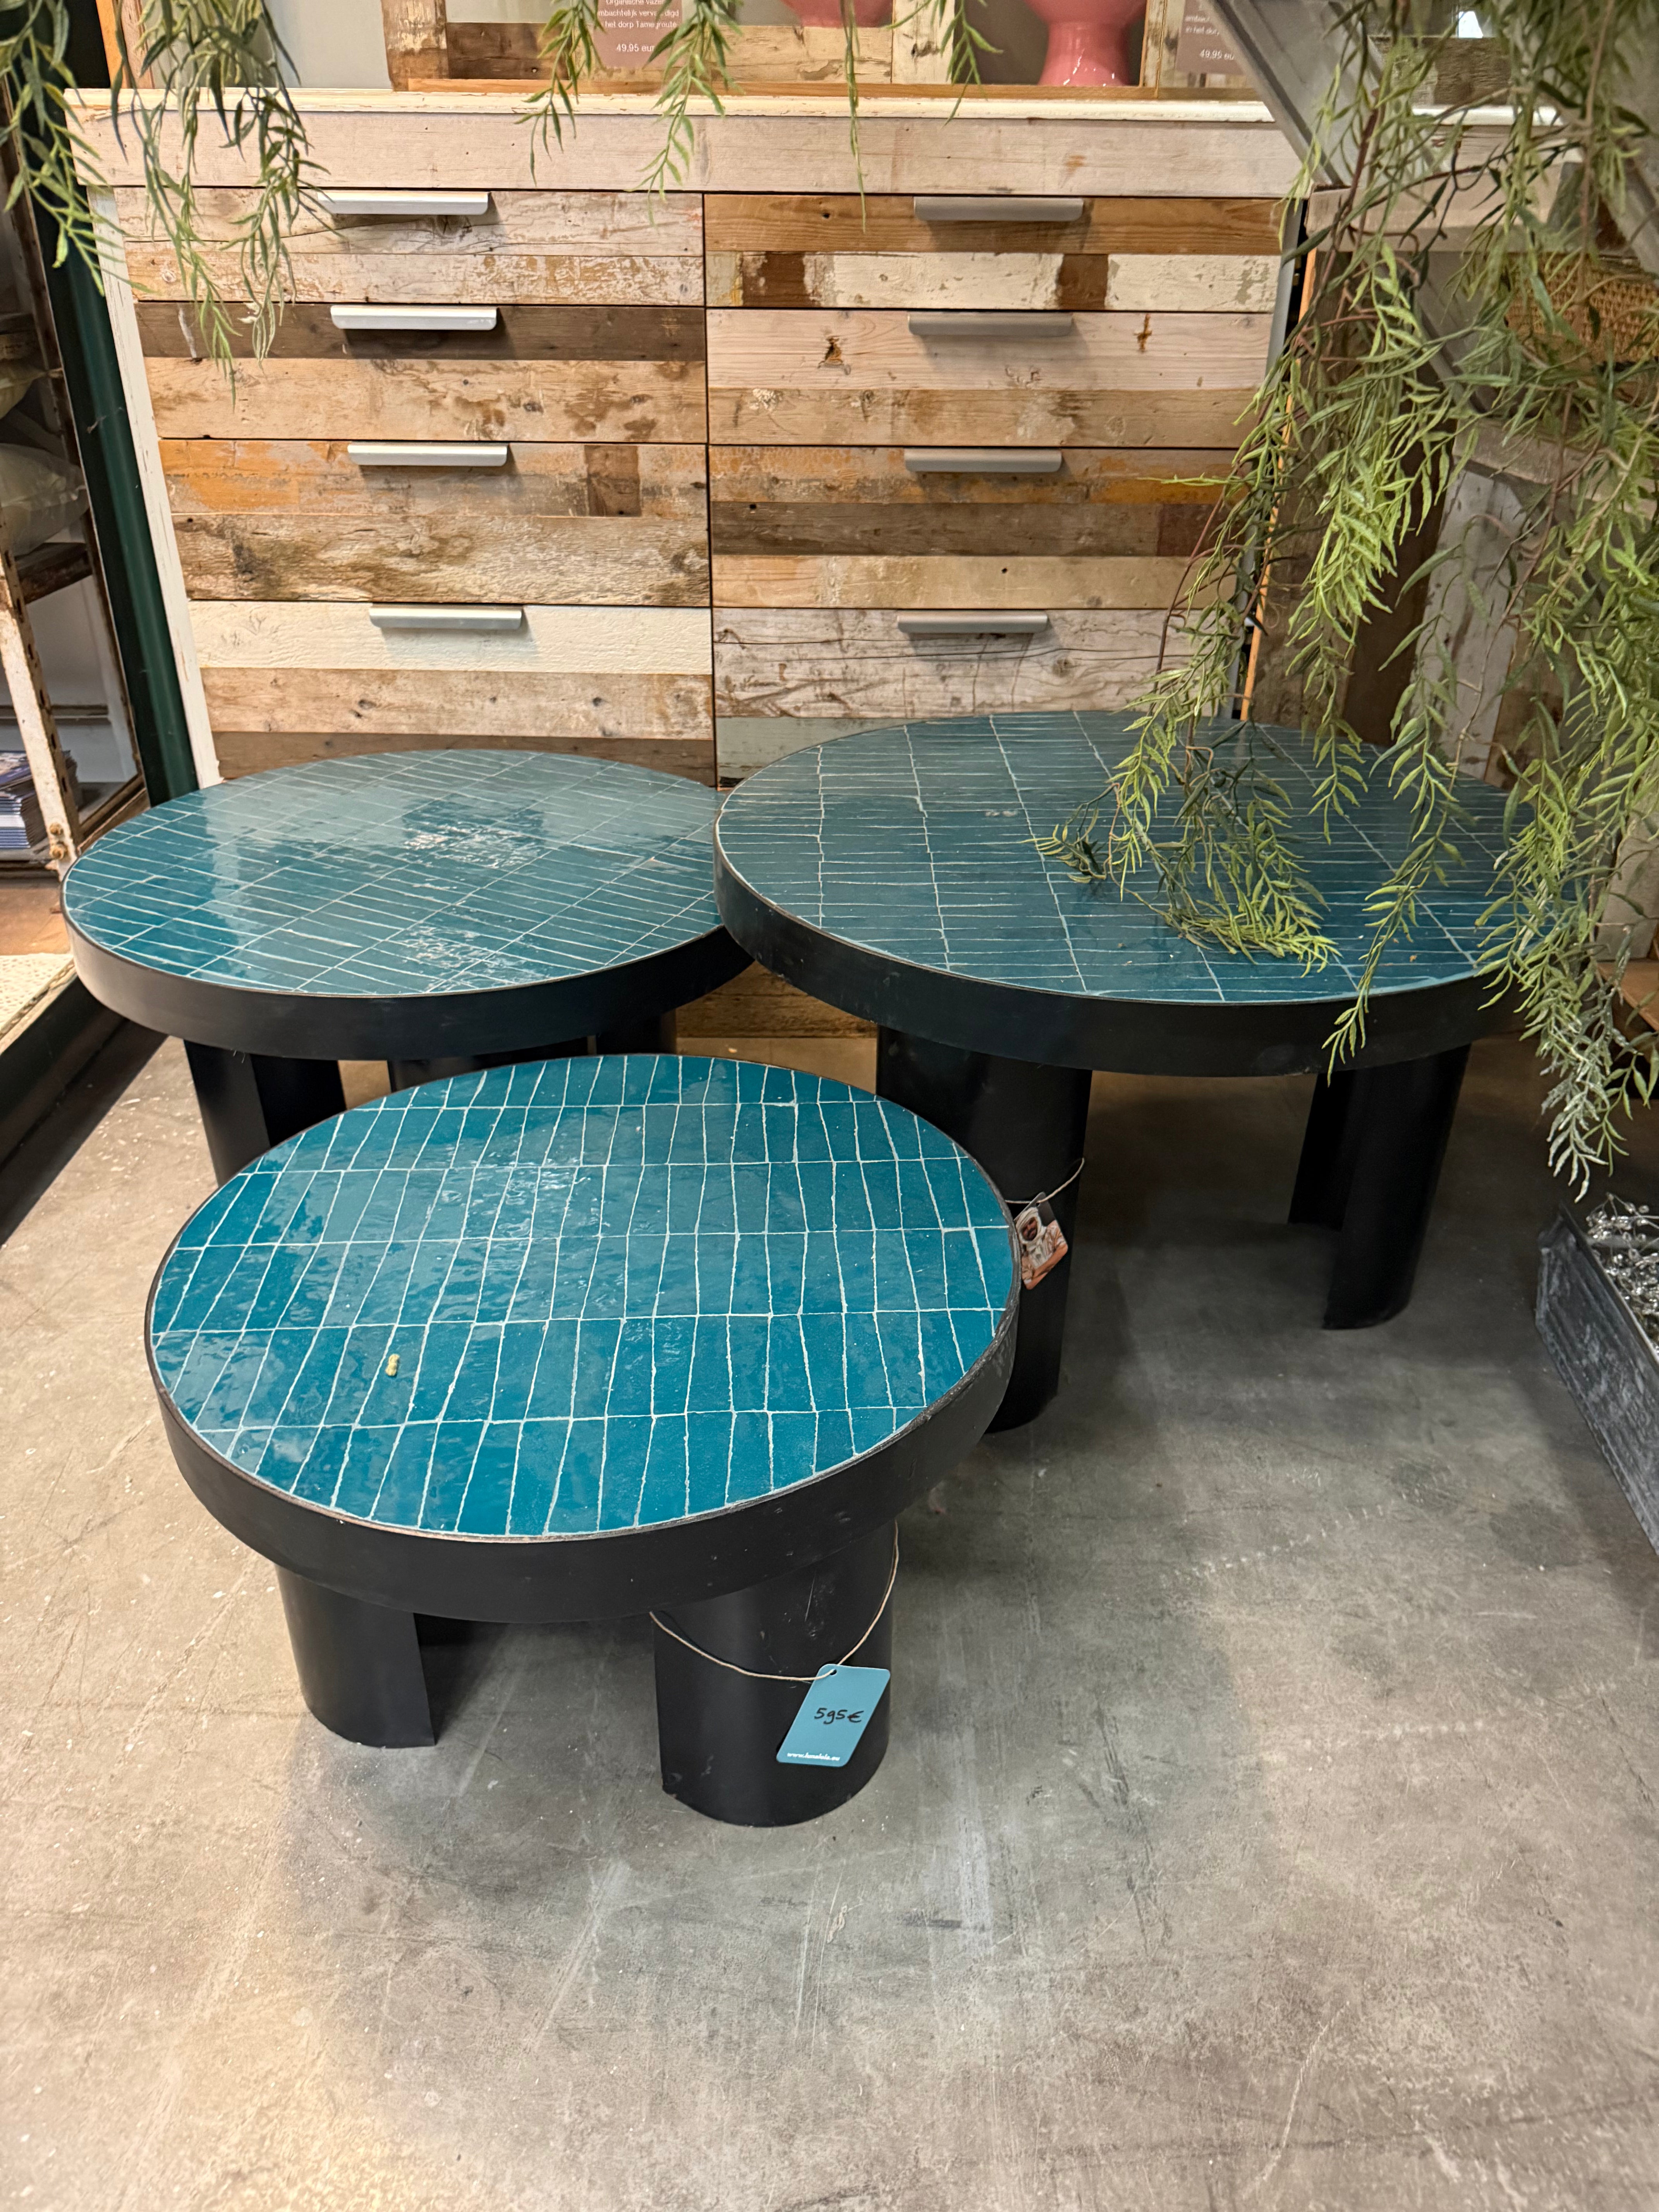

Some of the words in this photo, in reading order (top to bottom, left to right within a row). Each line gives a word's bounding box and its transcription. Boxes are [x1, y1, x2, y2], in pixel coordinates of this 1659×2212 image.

[597, 9, 637, 17] mbachtelijk
[618, 21, 634, 29] dorp
[617, 44, 639, 52] 49.95
[814, 1707, 864, 1724] 595€
